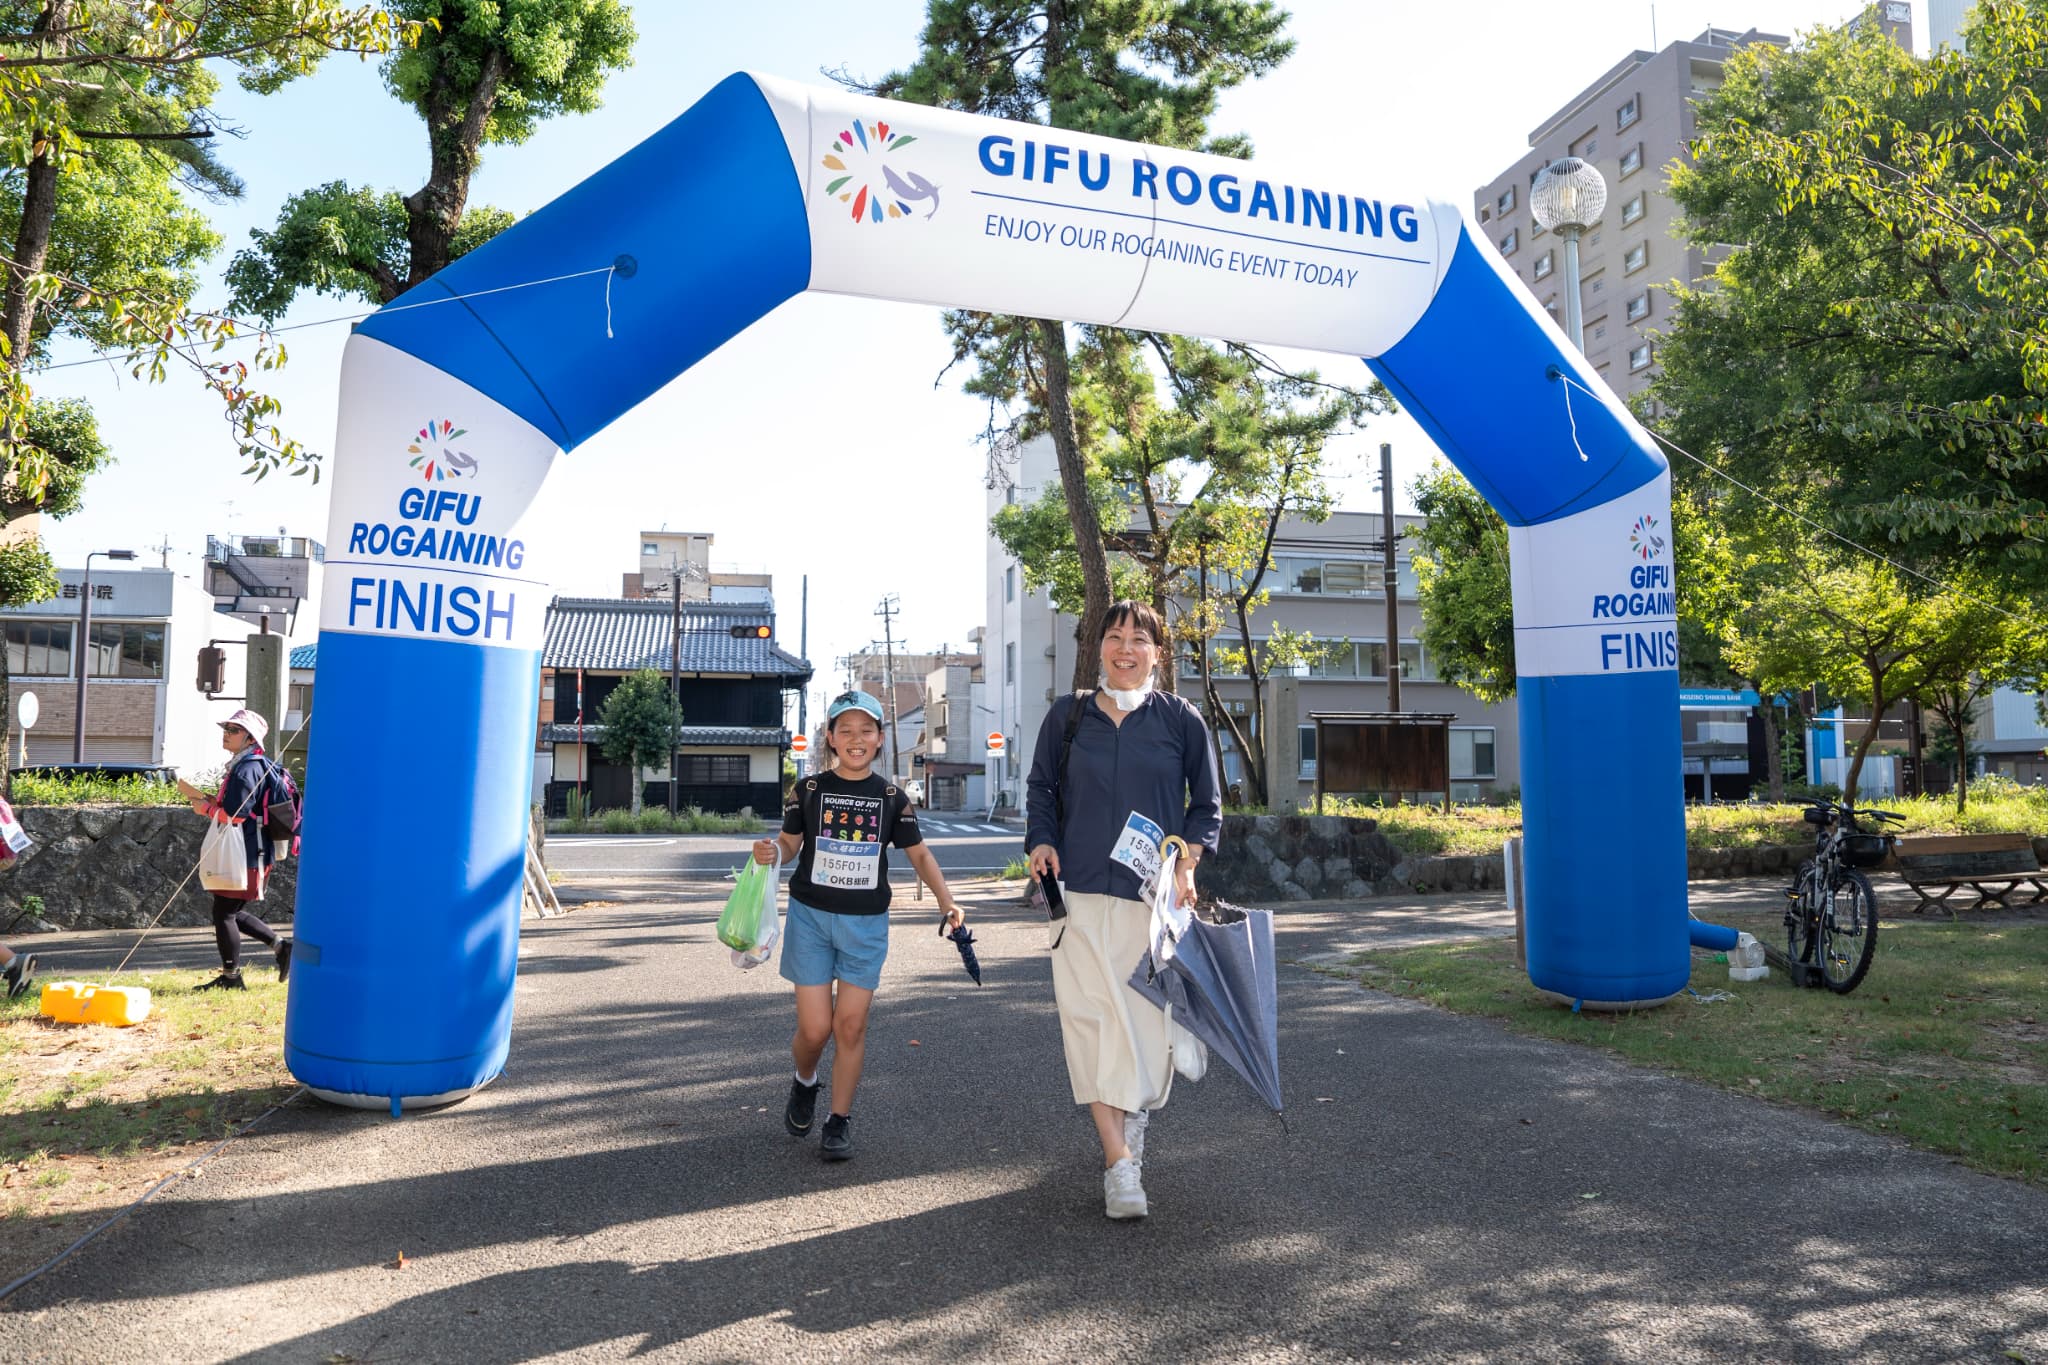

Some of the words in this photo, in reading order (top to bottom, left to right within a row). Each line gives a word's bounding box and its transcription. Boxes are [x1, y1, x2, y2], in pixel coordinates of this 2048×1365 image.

[978, 134, 1111, 192] GIFU
[1132, 158, 1420, 243] ROGAINING
[985, 213, 1057, 244] ENJOY
[1060, 223, 1107, 250] OUR
[1111, 229, 1224, 270] ROGAINING
[1228, 249, 1292, 279] EVENT
[1293, 258, 1359, 289] TODAY
[399, 487, 482, 526] GIFU
[348, 522, 526, 570] ROGAINING
[1630, 565, 1669, 589] GIFU
[348, 577, 515, 641] FINISH
[1600, 630, 1679, 670] FINIS
[824, 797, 855, 806] SOURCE
[839, 812, 849, 824] 2
[869, 815, 877, 827] 1
[838, 829, 847, 841] S
[822, 858, 871, 872] 155F01-1
